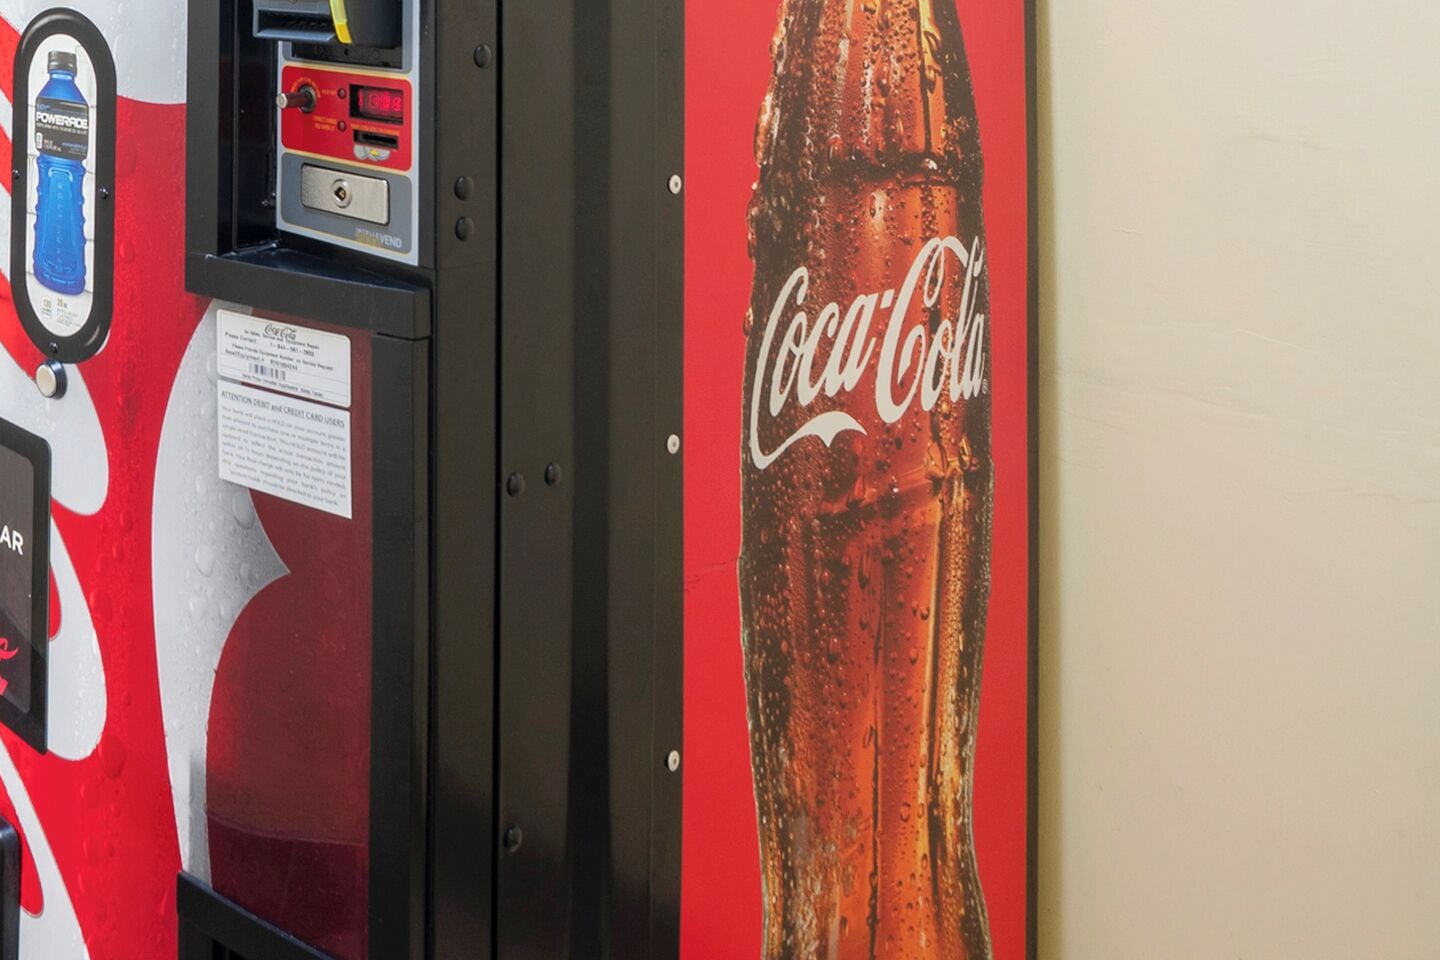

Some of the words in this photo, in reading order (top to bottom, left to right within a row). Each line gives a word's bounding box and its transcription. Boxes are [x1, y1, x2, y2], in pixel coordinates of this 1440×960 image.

[36, 111, 88, 129] POWERADE
[750, 235, 985, 470] Coca-Cola
[221, 391, 252, 405] ATTENTION
[253, 398, 269, 409] DEBIT
[271, 403, 282, 413] and
[284, 406, 305, 418] CREDIT
[306, 411, 323, 423] CARD
[325, 416, 344, 428] USERS
